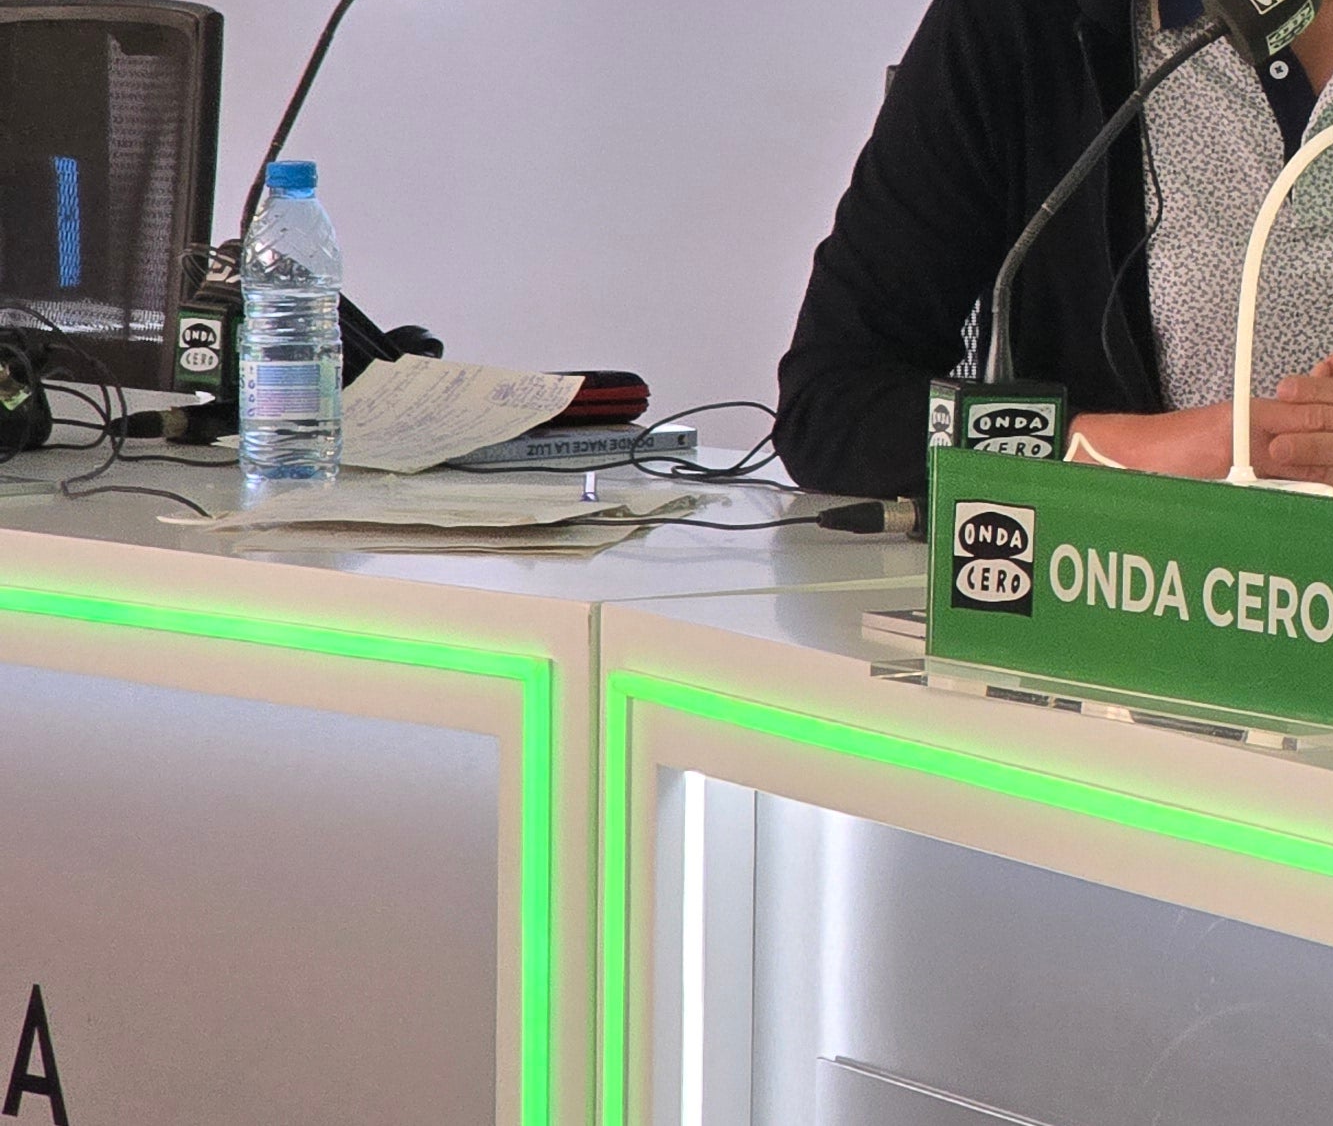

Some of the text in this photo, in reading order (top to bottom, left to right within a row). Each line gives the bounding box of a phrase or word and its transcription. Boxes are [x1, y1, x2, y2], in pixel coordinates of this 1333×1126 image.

[185, 329, 214, 342] ONDA
[186, 353, 213, 365] CERO
[980, 416, 1042, 431] ONDA
[573, 439, 606, 454] NACE
[965, 524, 1021, 548] ONDA
[967, 566, 1020, 594] CERO
[1050, 544, 1189, 620] ONDA
